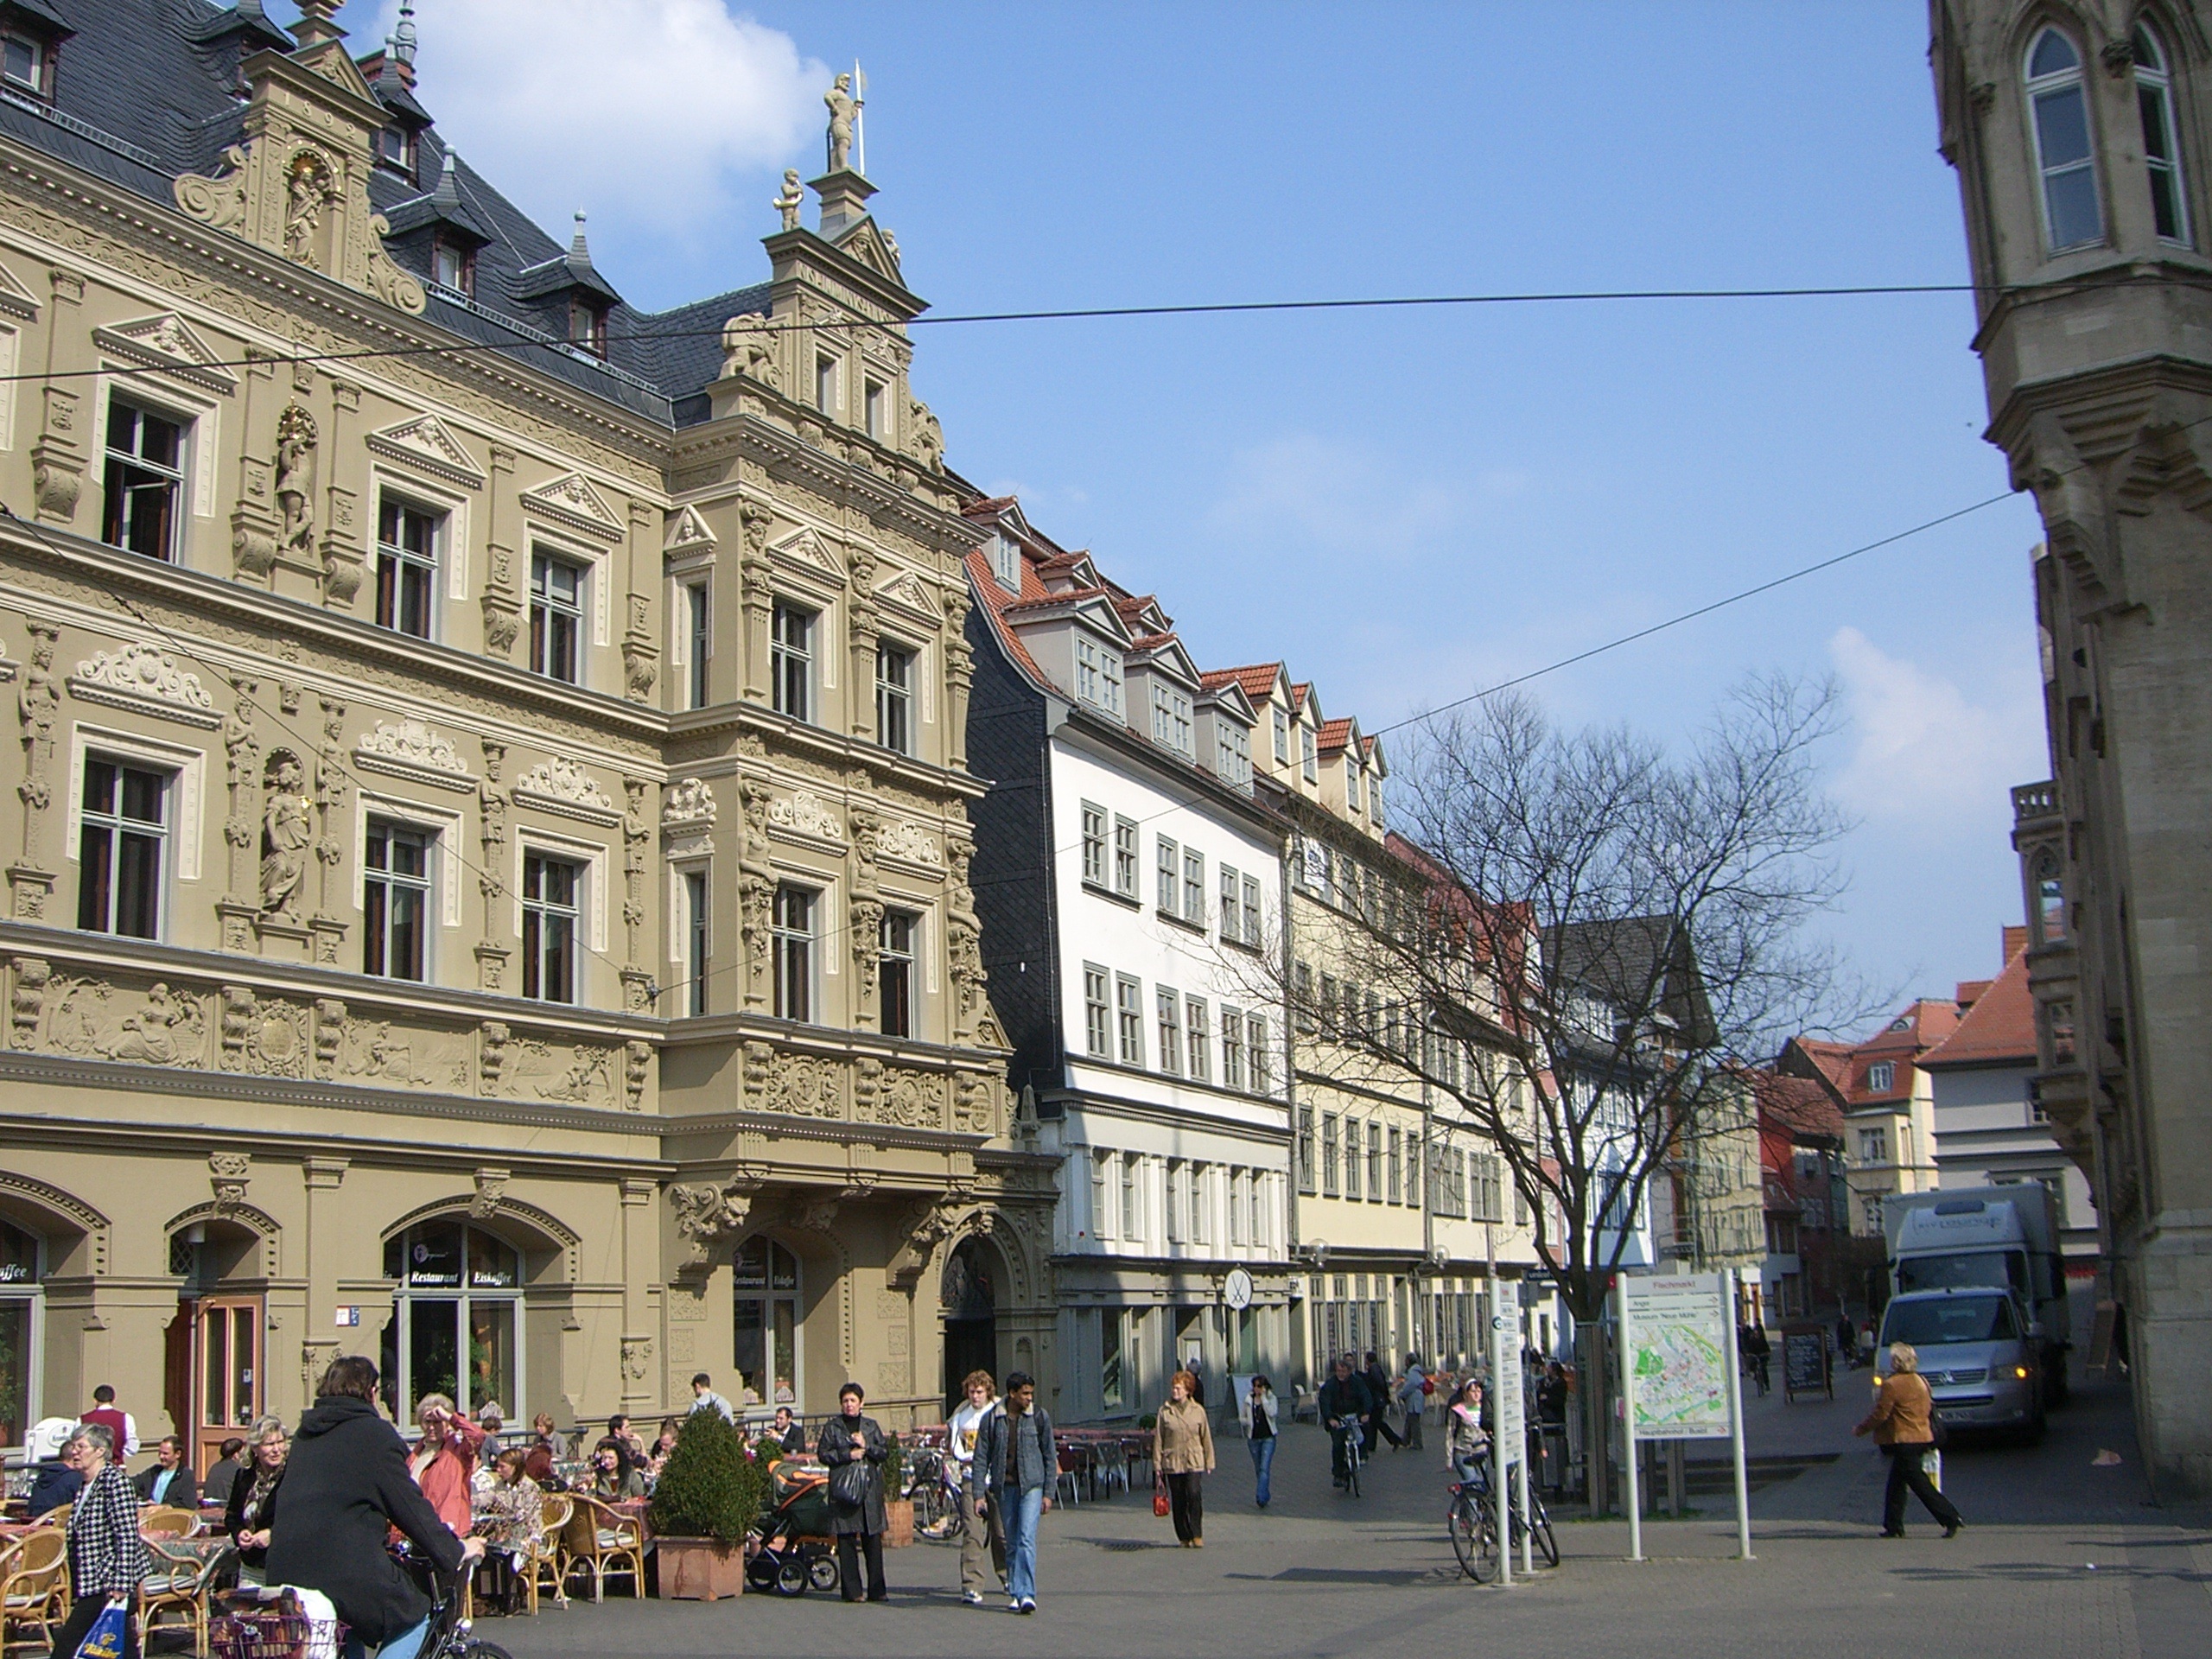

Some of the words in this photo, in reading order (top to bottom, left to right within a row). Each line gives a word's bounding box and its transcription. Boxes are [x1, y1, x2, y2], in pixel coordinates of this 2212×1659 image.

[283, 92, 356, 140] 1892
[410, 1270, 459, 1284] Restaurant
[474, 1271, 512, 1287] Eiskaffee
